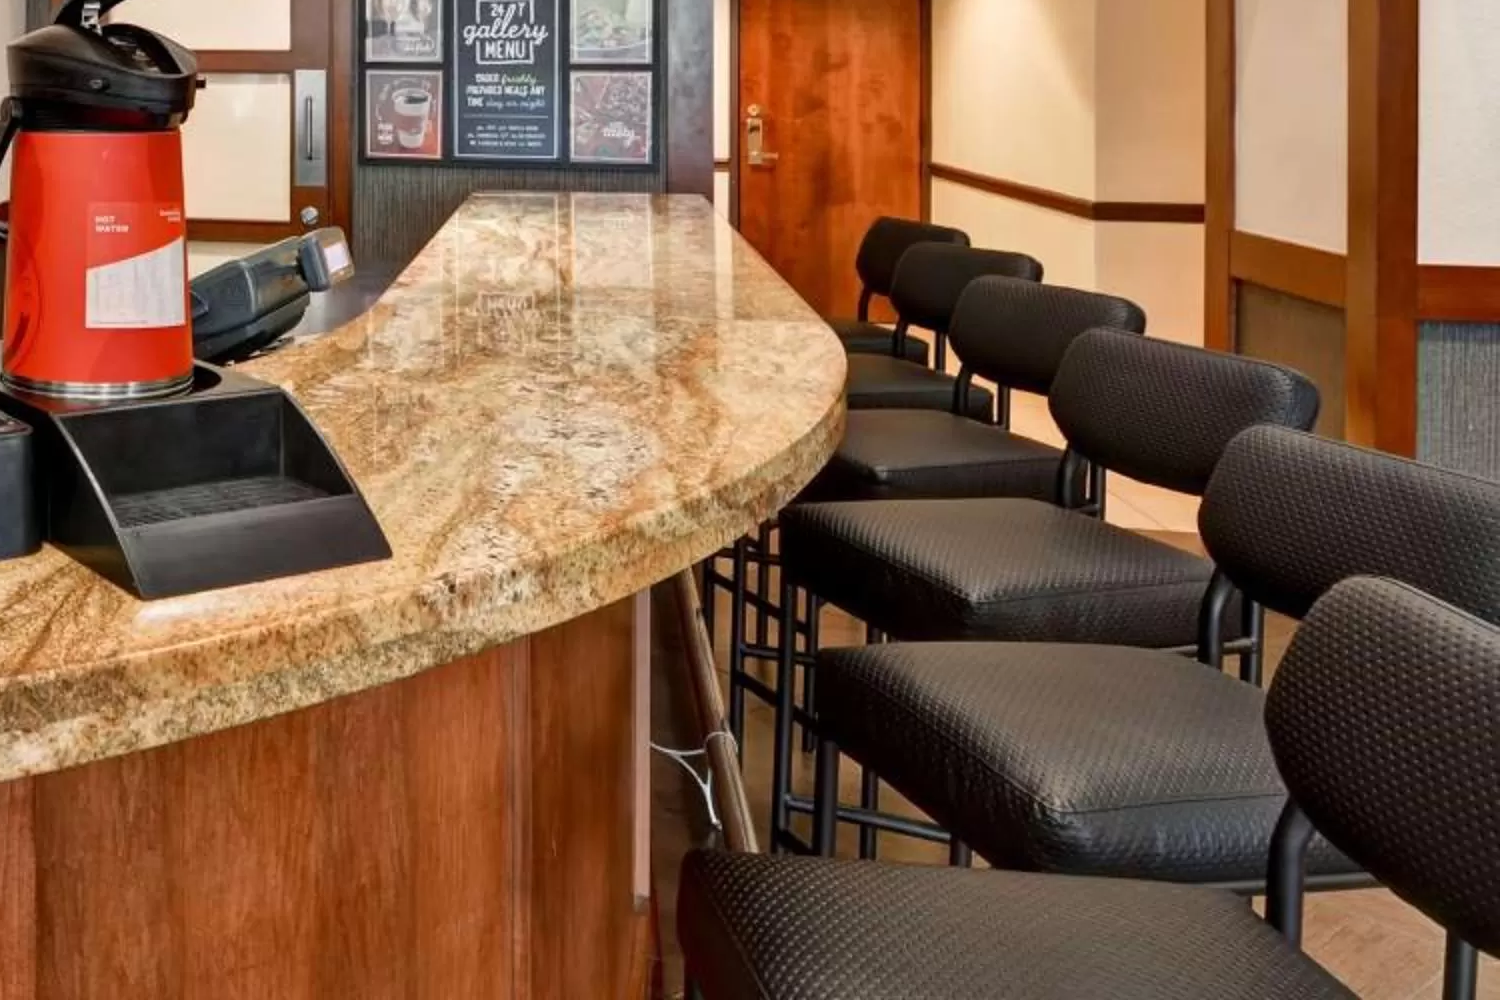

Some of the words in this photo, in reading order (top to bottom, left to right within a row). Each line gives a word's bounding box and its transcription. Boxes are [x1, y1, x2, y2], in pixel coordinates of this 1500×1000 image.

[463, 3, 549, 46] gallery
[485, 40, 525, 58] MENU
[467, 96, 484, 107] TIME
